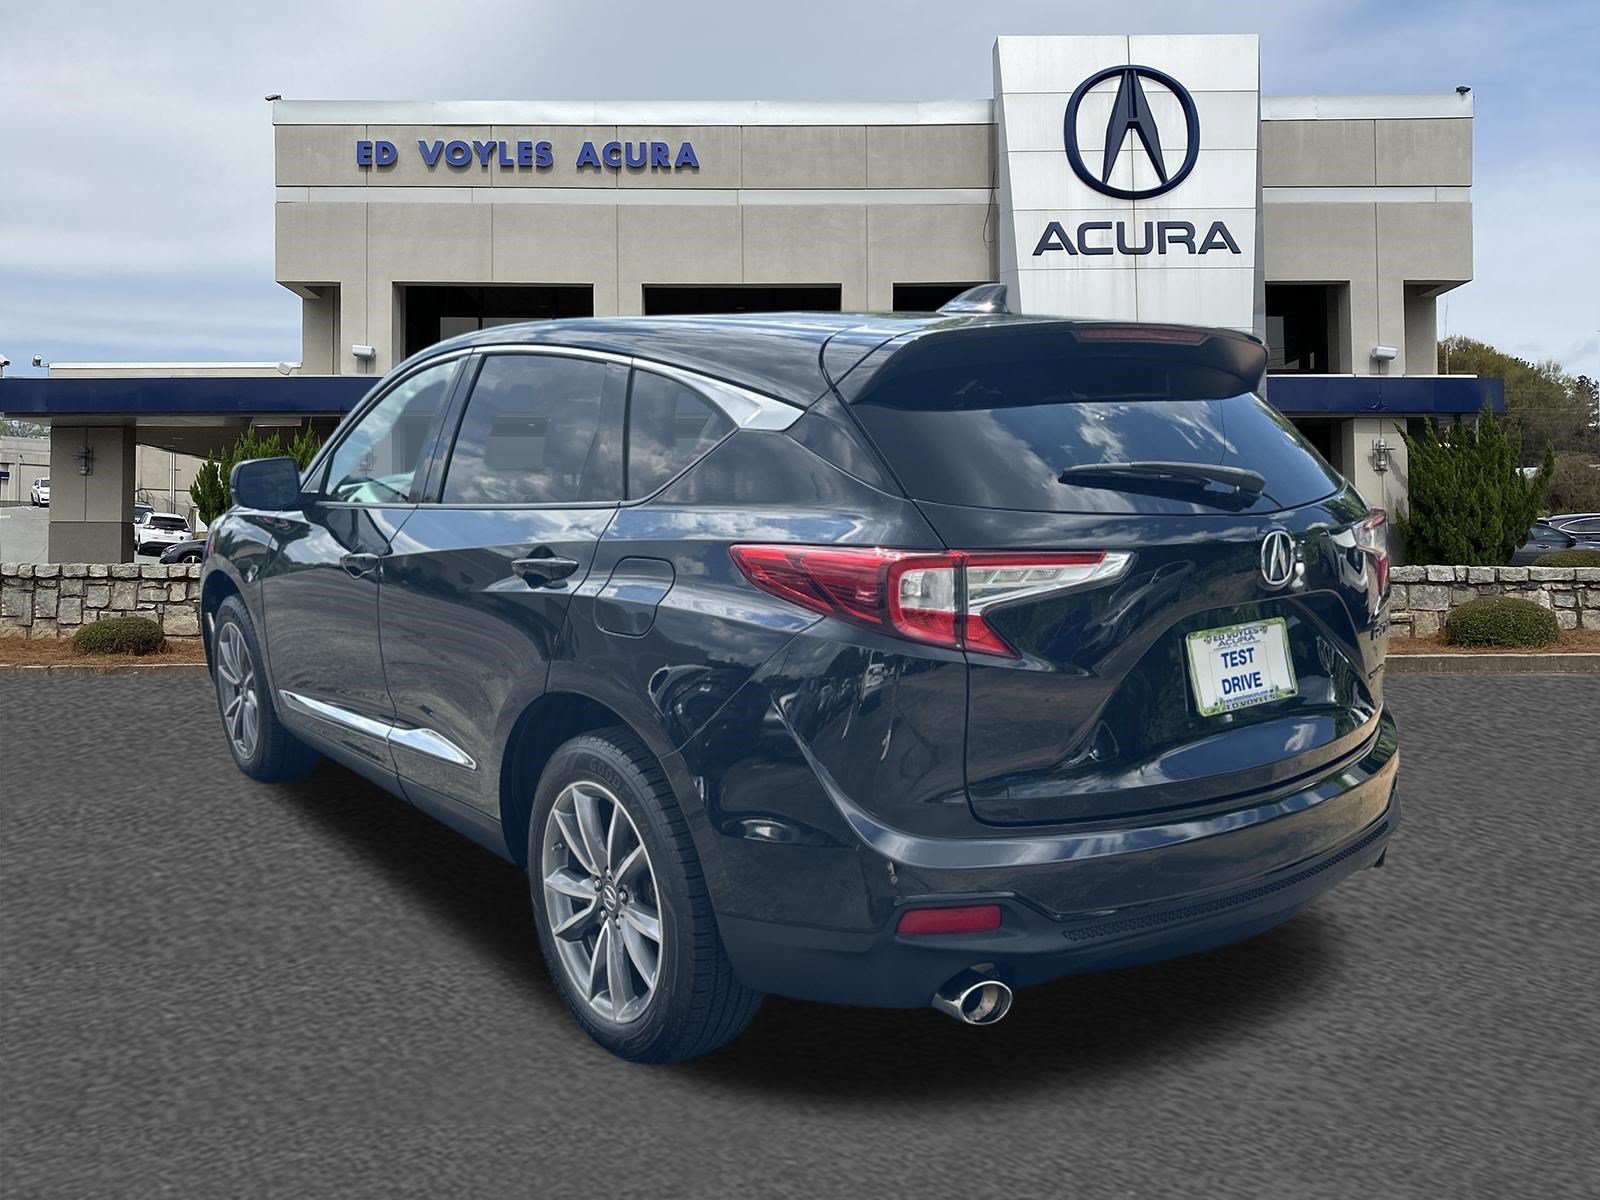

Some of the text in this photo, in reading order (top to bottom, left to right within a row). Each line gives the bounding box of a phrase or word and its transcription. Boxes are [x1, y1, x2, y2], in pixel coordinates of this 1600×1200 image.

[356, 140, 700, 168] ED VOYLES ACURA
[1032, 221, 1242, 256] ACURA
[1218, 635, 1256, 647] ACURA
[1220, 647, 1255, 669] TEST
[1221, 671, 1263, 695] DRIVE
